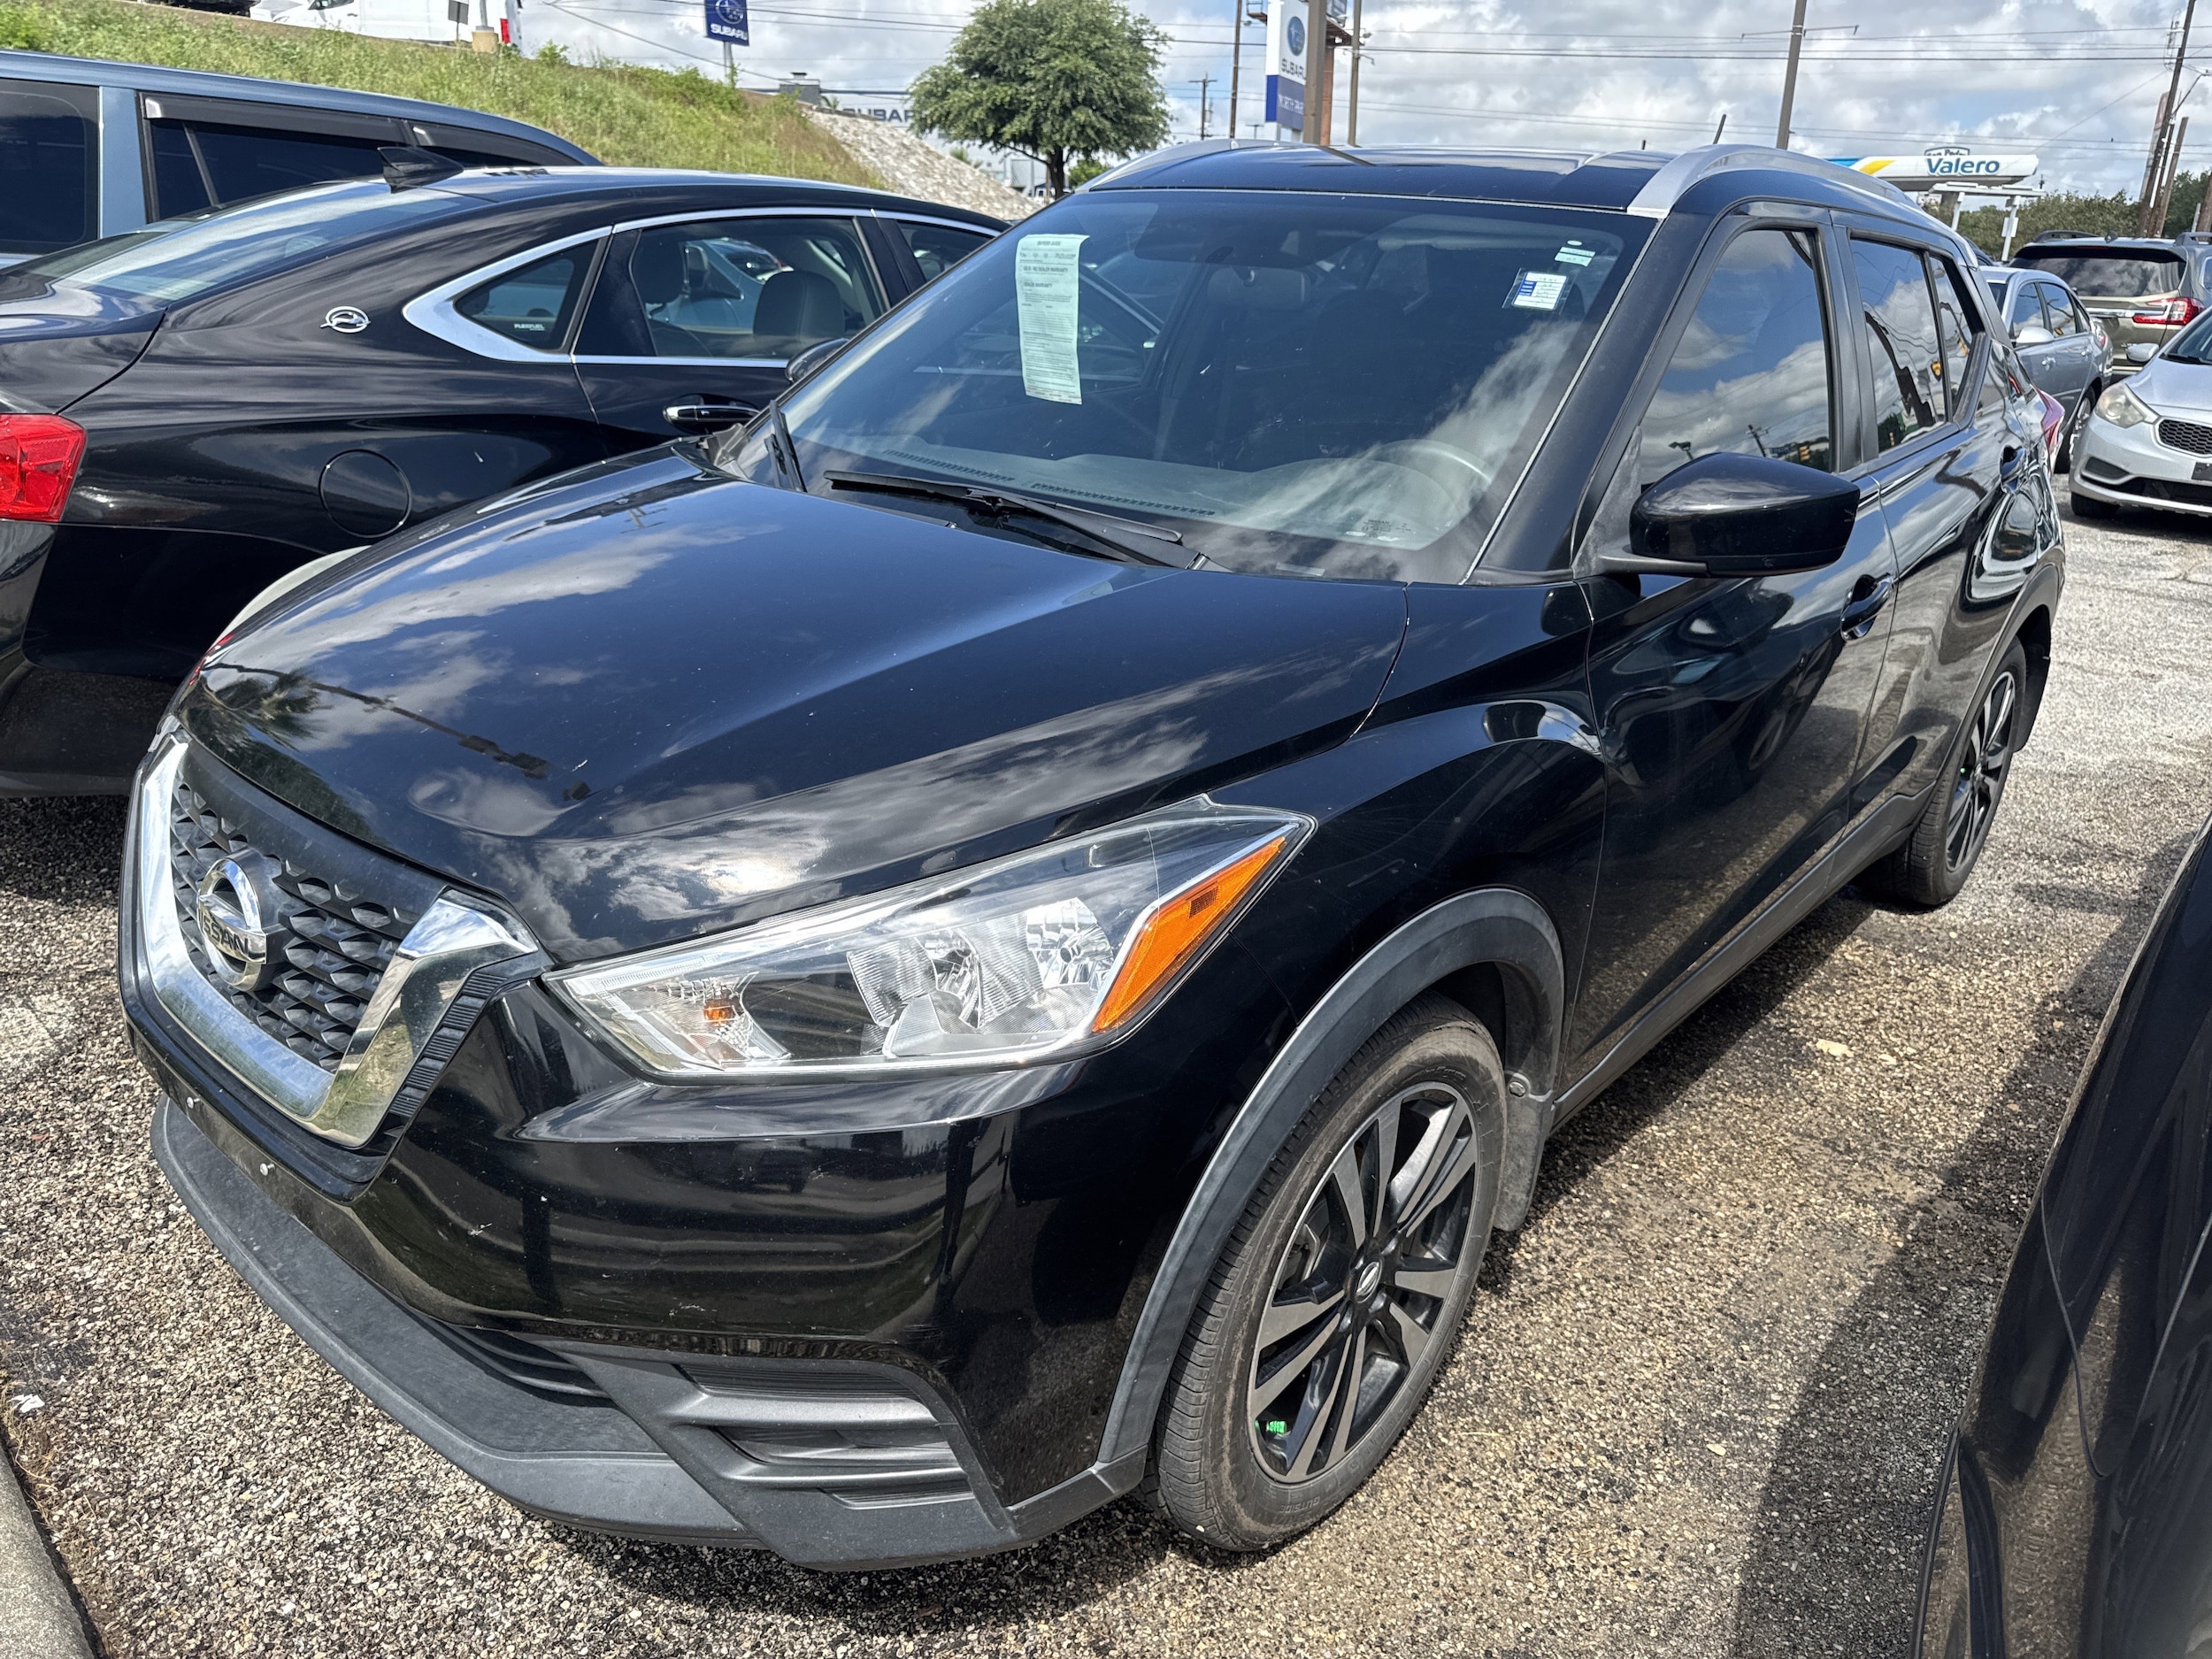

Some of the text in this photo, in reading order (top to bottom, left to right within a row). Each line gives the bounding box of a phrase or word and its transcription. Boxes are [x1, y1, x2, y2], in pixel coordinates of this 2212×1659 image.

[710, 23, 748, 41] SUBARU
[842, 108, 916, 123] BAR
[1927, 157, 2000, 173] Valero
[199, 908, 249, 955] ISSAN
[1279, 1495, 1320, 1514] OUTSIDE
